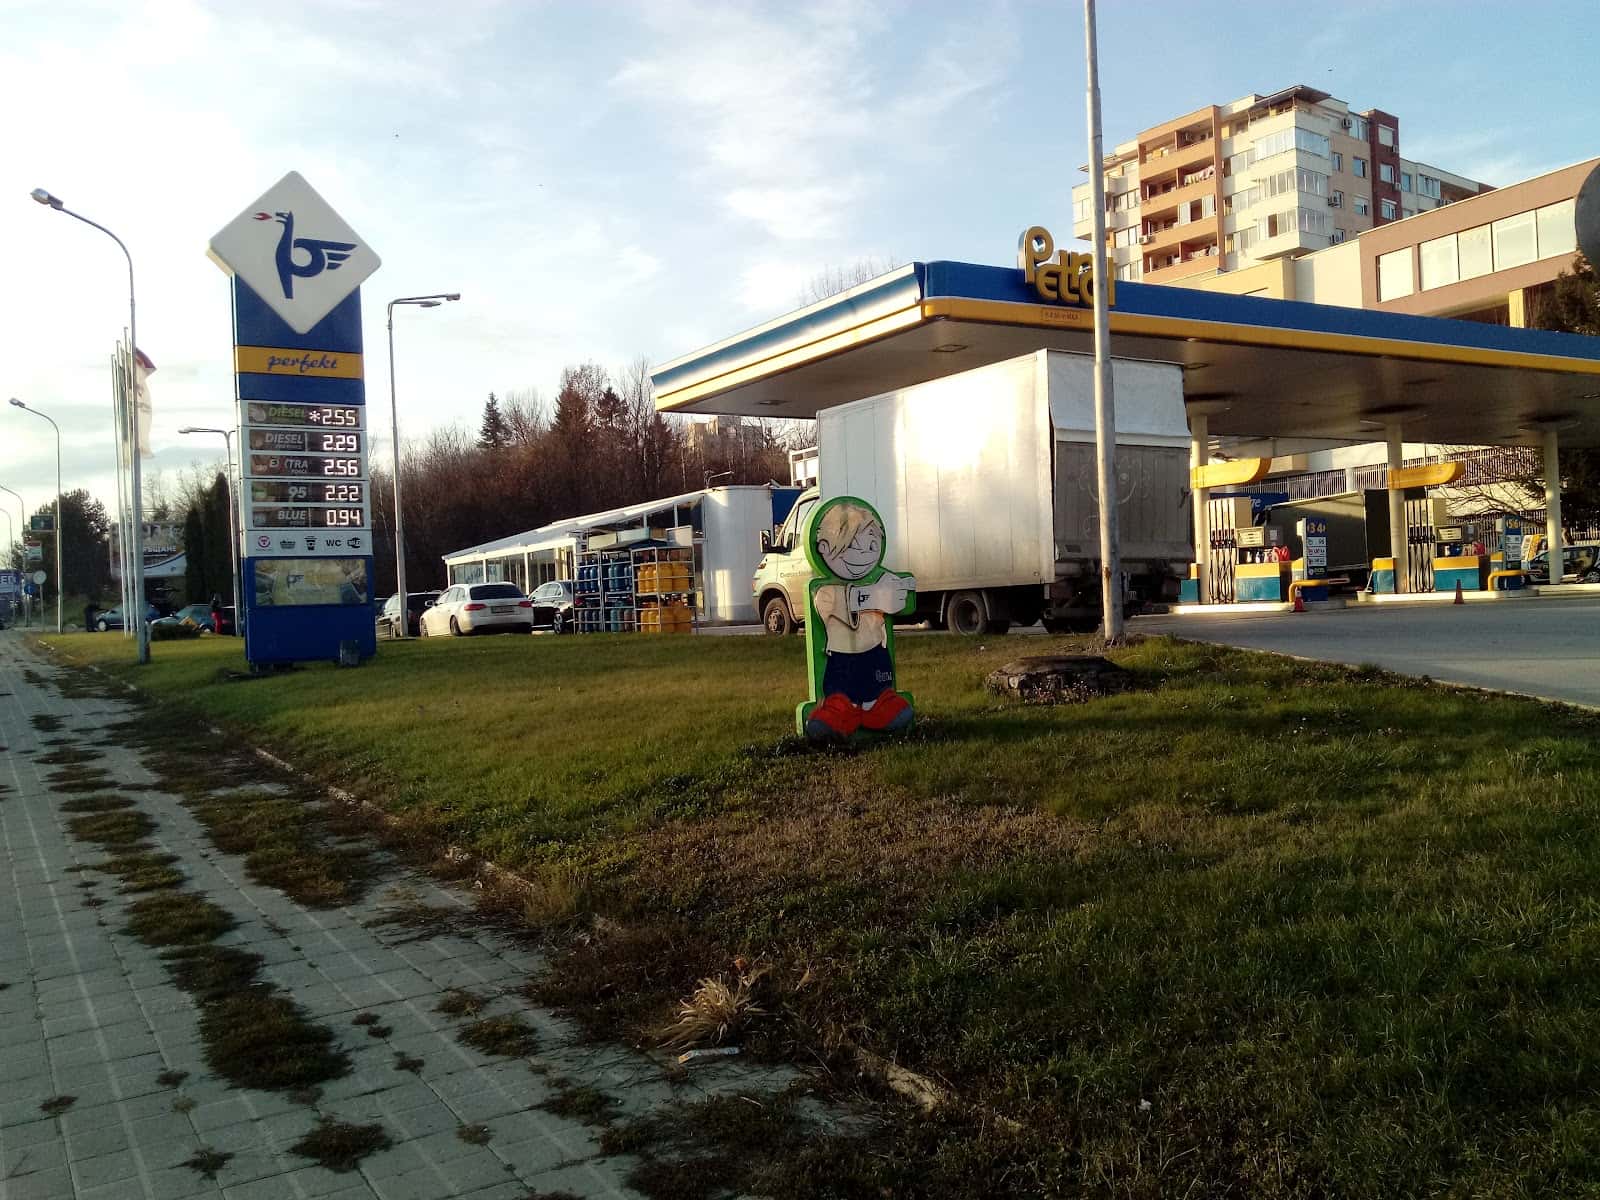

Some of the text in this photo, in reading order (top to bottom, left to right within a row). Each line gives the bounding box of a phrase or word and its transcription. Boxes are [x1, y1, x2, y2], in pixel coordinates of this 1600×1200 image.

[1022, 225, 1116, 306] Petrol
[267, 353, 337, 373] perfekt
[269, 407, 305, 418] DIESEL
[264, 432, 304, 445] DIESEL
[288, 486, 307, 499] 95
[278, 510, 307, 521] BLUE
[326, 538, 342, 548] WC
